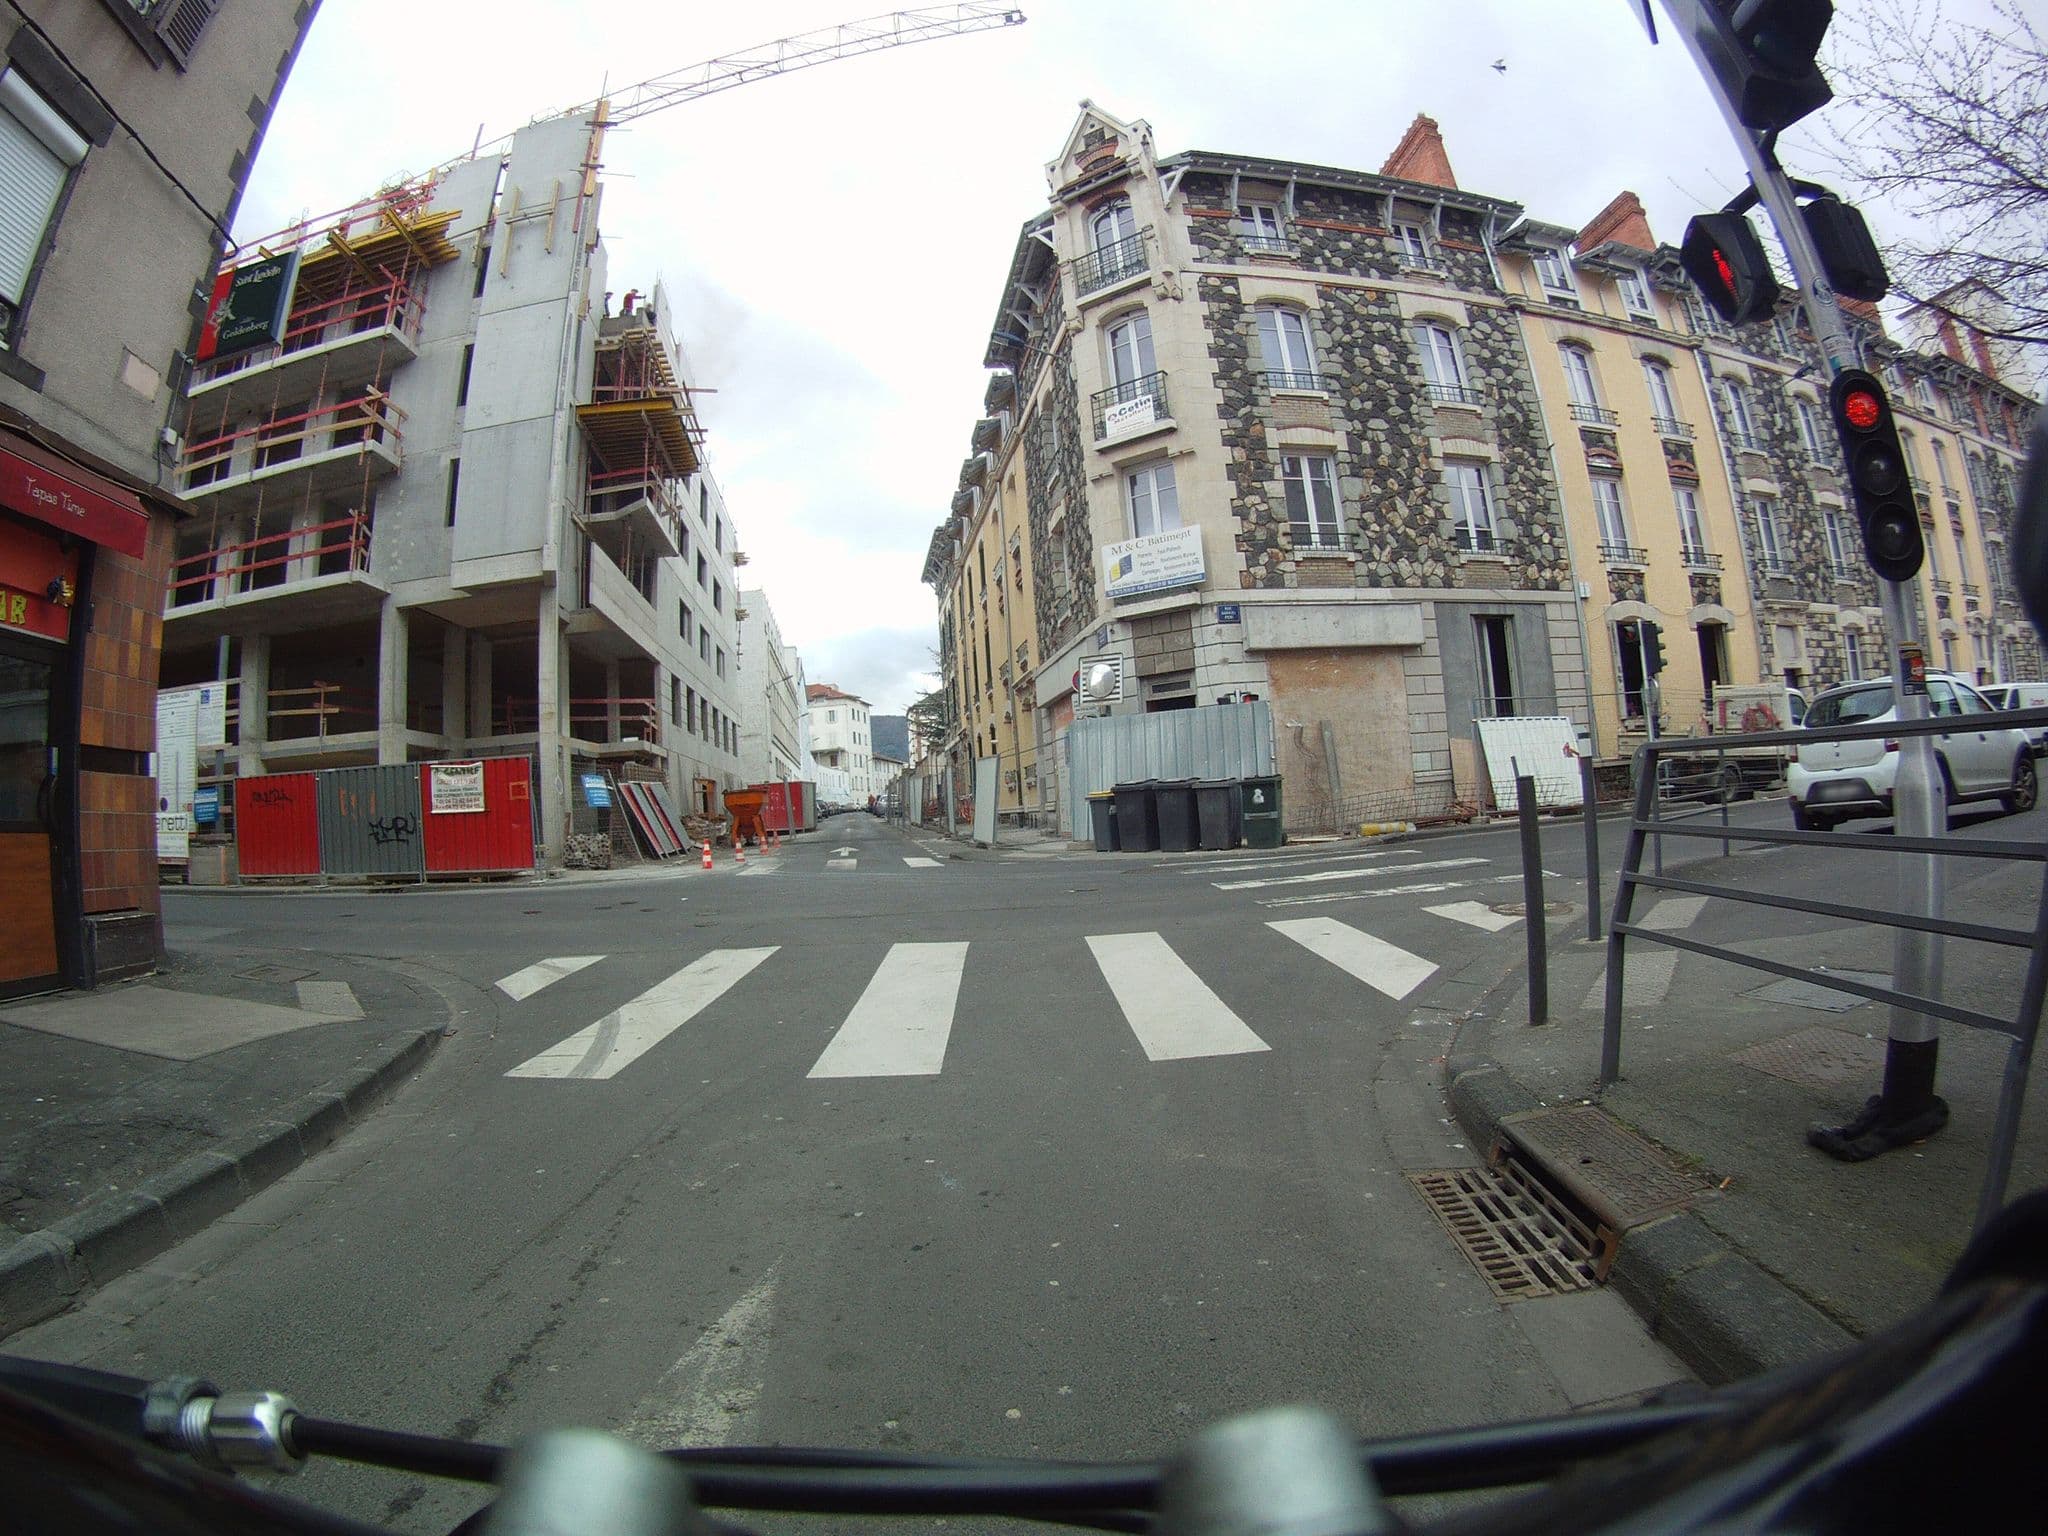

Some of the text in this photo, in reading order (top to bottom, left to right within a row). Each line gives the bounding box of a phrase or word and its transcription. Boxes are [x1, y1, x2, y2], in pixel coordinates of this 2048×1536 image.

[26, 476, 87, 518] Tapas Time
[1112, 546, 1122, 555] M
[1125, 543, 1133, 552] &
[1135, 540, 1145, 549] C
